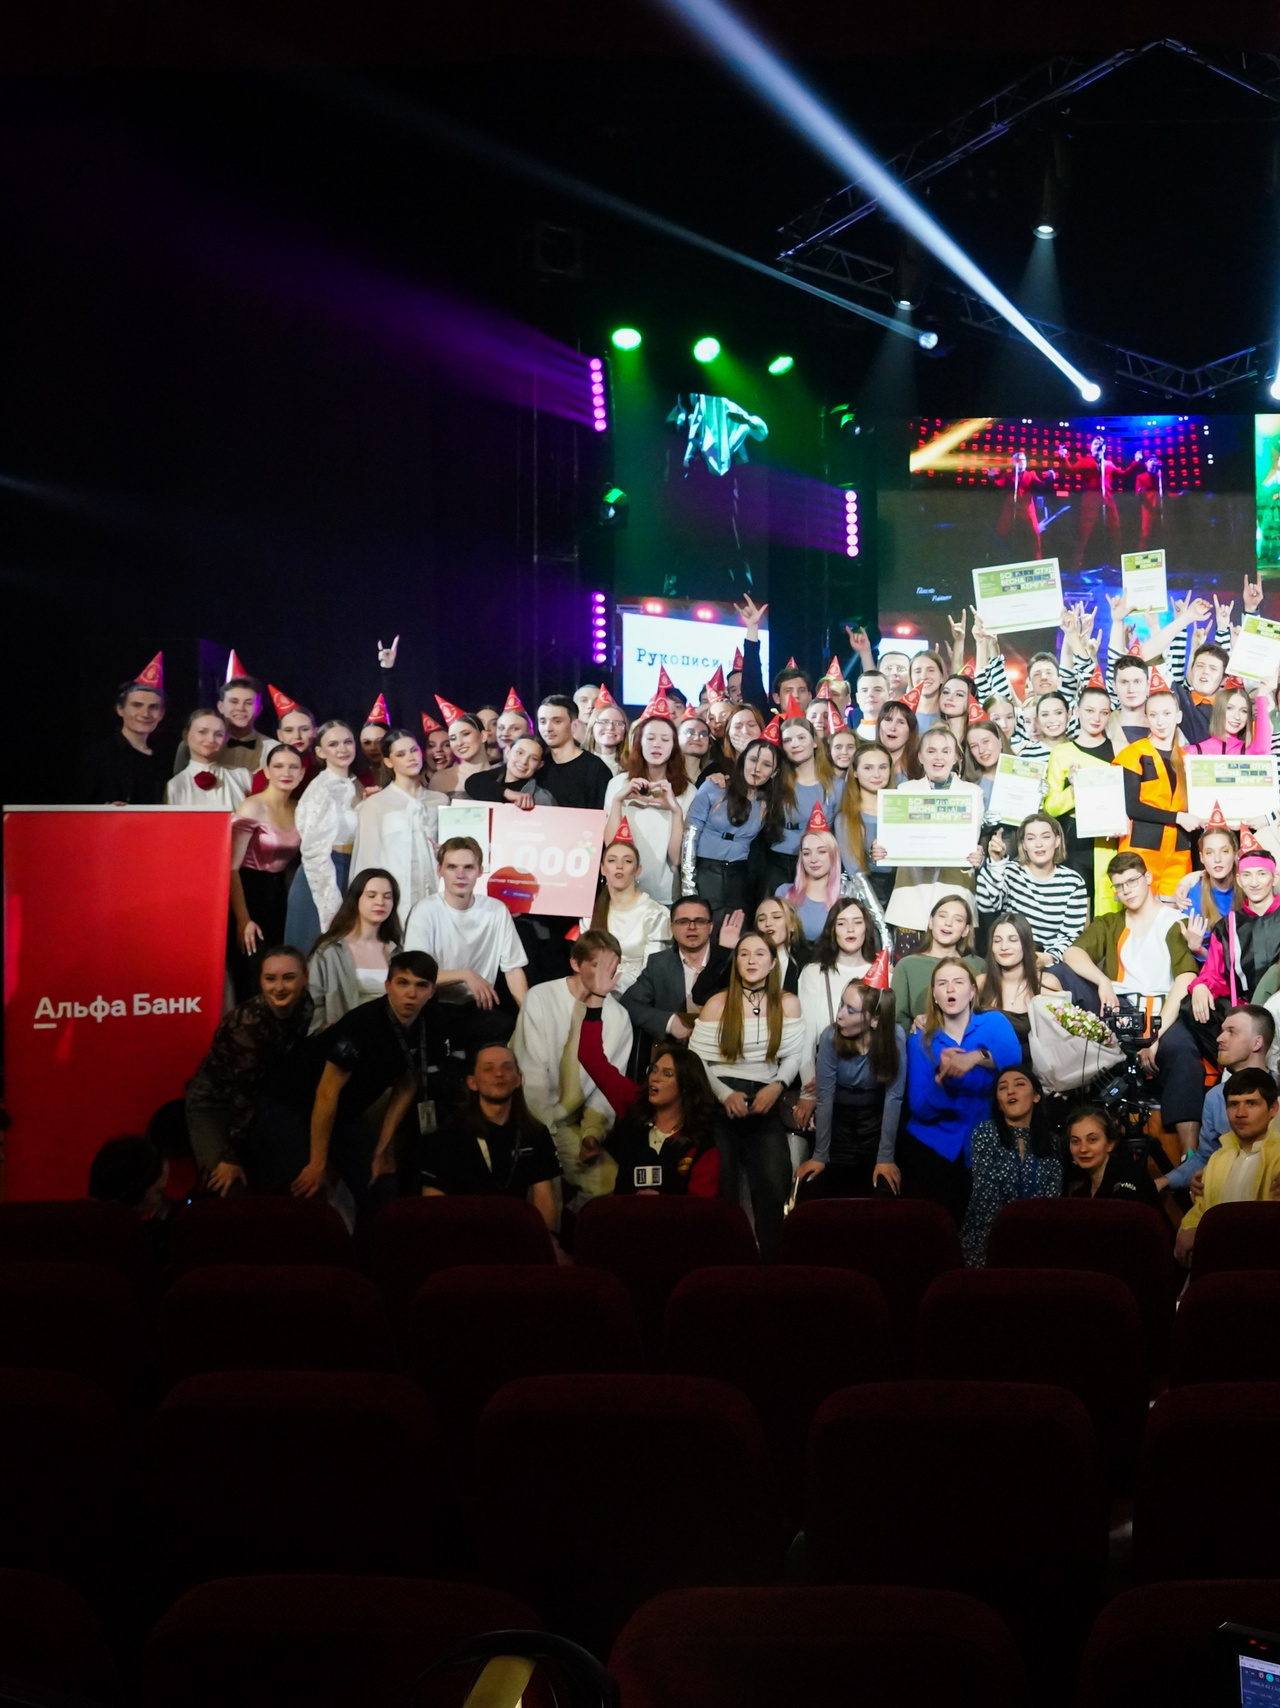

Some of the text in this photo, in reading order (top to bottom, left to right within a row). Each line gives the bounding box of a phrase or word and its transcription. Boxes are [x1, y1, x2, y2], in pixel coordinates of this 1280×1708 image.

[637, 648, 720, 668] Рукописи
[34, 993, 202, 1024] Альфа Банк
